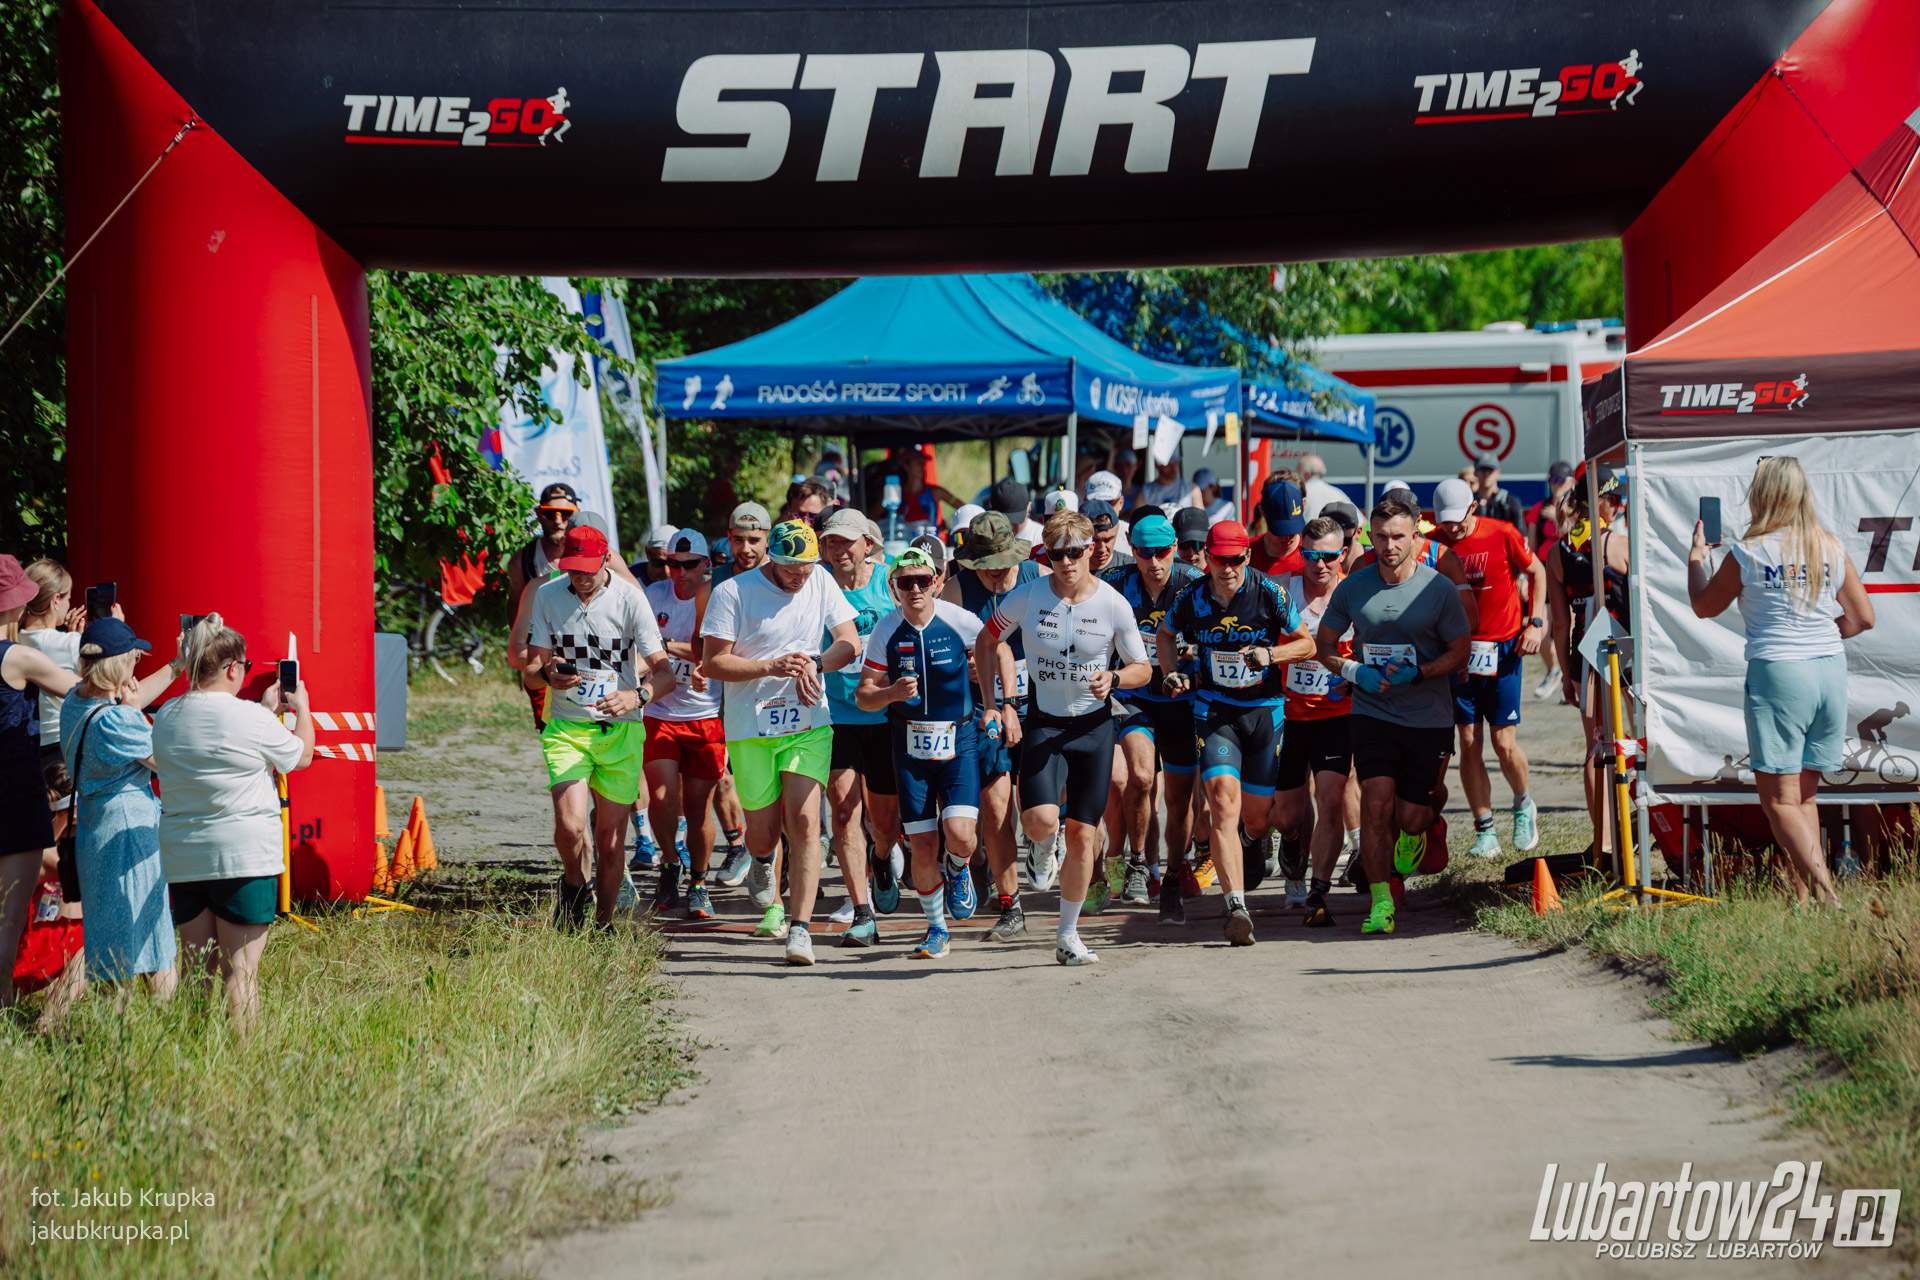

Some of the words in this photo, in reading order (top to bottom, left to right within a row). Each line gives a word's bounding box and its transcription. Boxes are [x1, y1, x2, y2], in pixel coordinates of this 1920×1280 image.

[1413, 61, 1634, 118] TIME2GO
[343, 94, 557, 147] TIME2GO
[660, 36, 1317, 183] START
[757, 380, 837, 404] RADOŚĆ
[841, 383, 900, 402] PRZEZ
[905, 382, 968, 402] SPORT
[1660, 380, 1801, 413] TIME2GO
[1474, 418, 1501, 451] S
[1196, 630, 1223, 643] ike
[1060, 673, 1089, 682] TEA
[577, 682, 606, 698] 5/1
[770, 708, 801, 725] 5/2
[914, 735, 950, 751] 15/1
